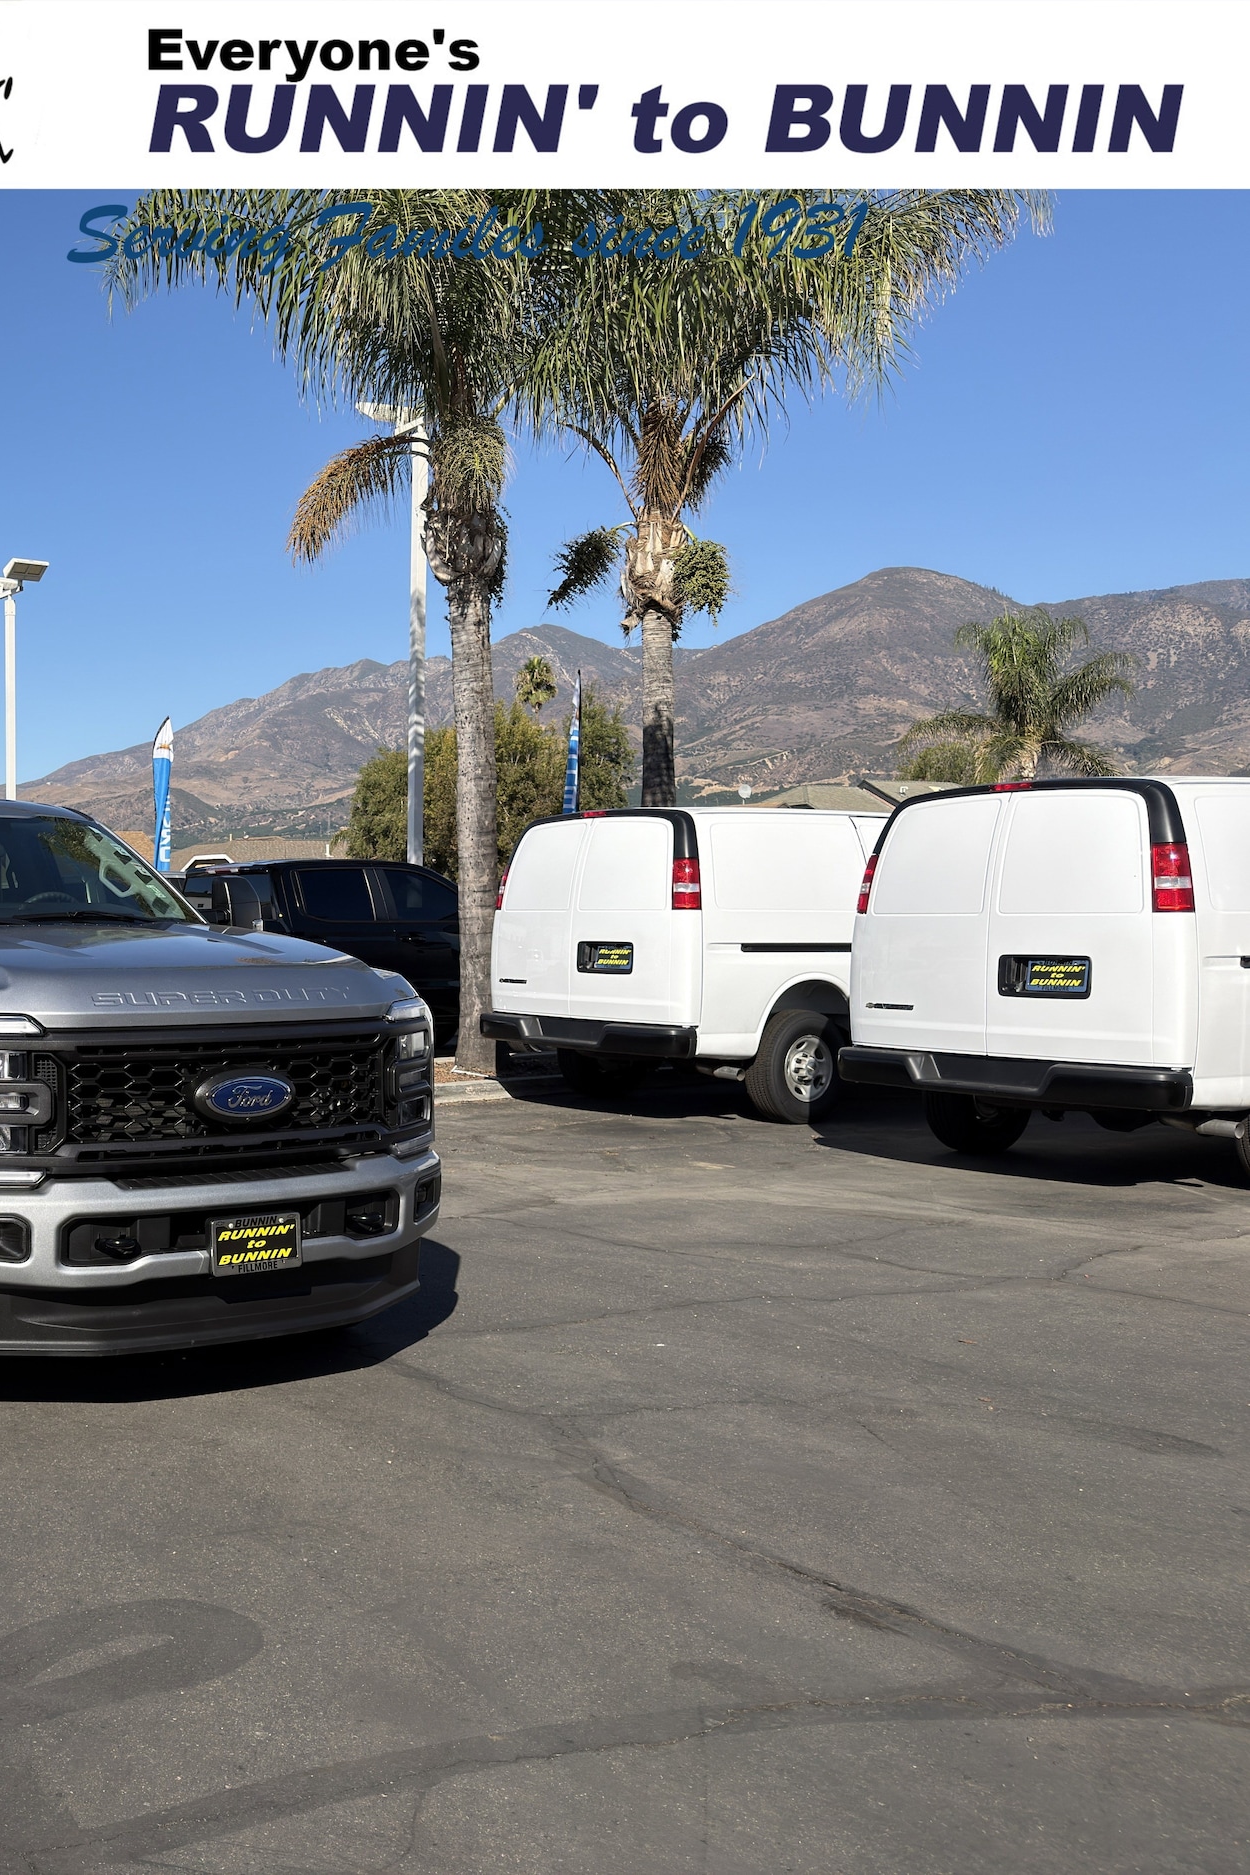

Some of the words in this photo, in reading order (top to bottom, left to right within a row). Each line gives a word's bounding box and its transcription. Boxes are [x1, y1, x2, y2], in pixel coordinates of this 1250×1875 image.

[91, 989, 247, 1007] SUPER
[251, 985, 350, 1002] DUTY
[227, 1085, 273, 1108] Ford
[235, 1215, 277, 1228] BUNNIN
[217, 1223, 295, 1241] RUNNIN'
[247, 1239, 267, 1249] to
[219, 1247, 292, 1266] BUNNIN
[238, 1261, 278, 1273] FILLMORE
